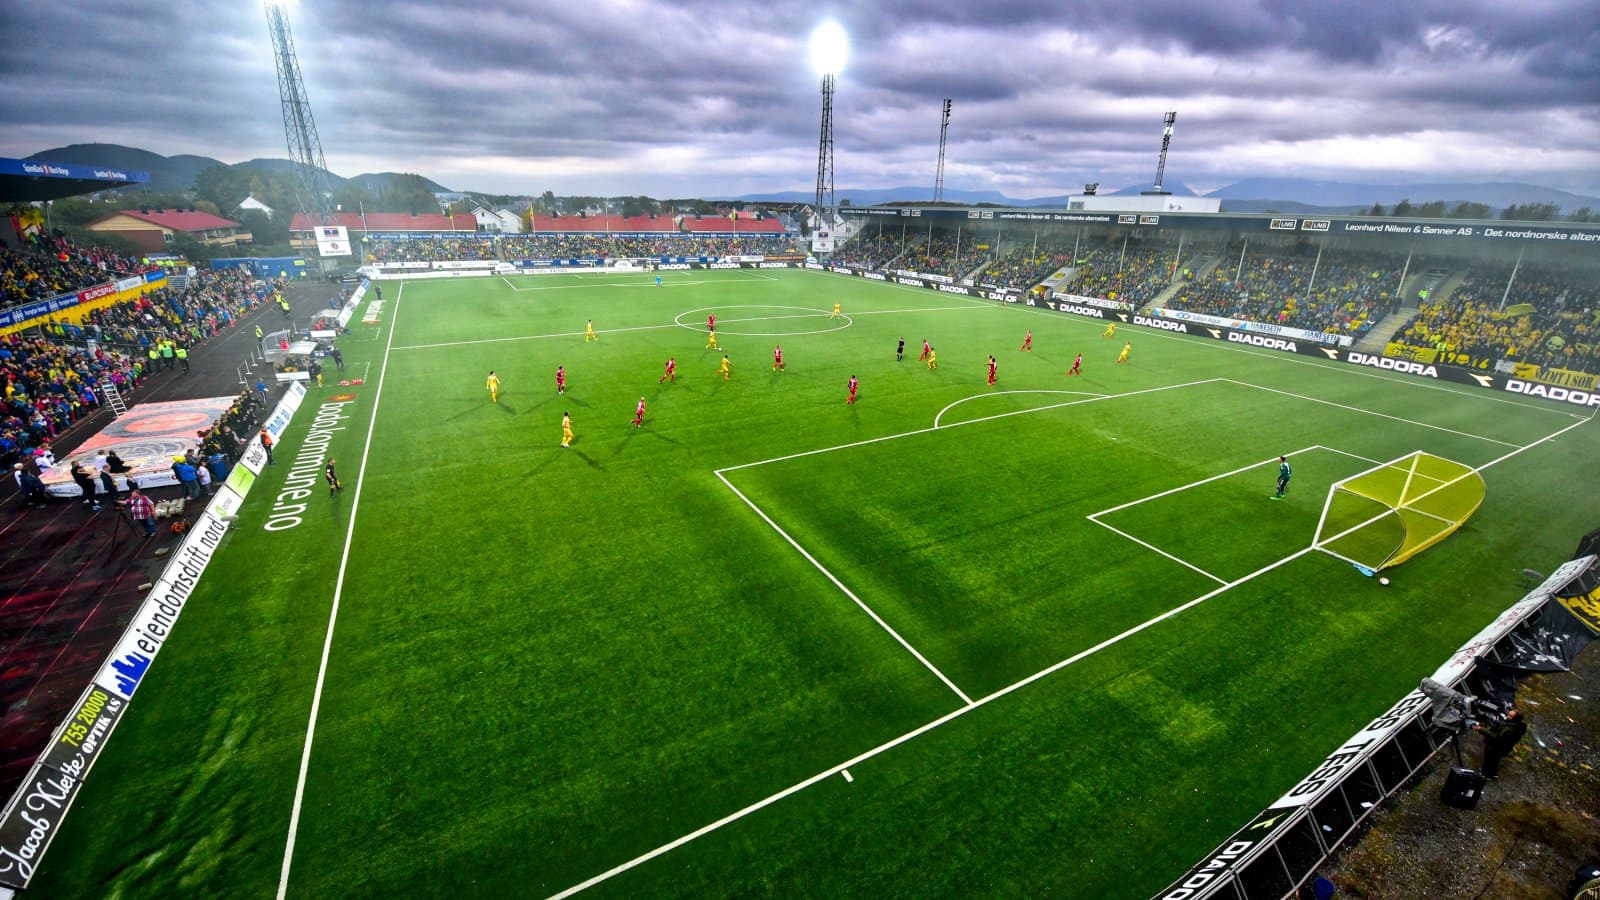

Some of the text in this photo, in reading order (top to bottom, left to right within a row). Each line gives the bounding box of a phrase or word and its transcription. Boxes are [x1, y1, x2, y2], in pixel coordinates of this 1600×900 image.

[1345, 223, 1383, 232] Leonhard
[1384, 224, 1411, 233] Nilsen
[1457, 228, 1473, 236] AS
[1484, 228, 1503, 237] Det
[1505, 230, 1568, 240] nordnorske
[939, 285, 968, 295] DIADORA
[1059, 303, 1103, 319] DIADORA
[1133, 315, 1187, 333] DIADORA
[1228, 332, 1297, 352] DIADORA
[1347, 352, 1438, 377] DIADORA
[136, 516, 225, 654] eiendomsdrift nord
[61, 690, 109, 748] 755 20000
[82, 697, 122, 754] OPTIK AS
[1289, 737, 1376, 797] TESS
[0, 810, 50, 880] Jacob
